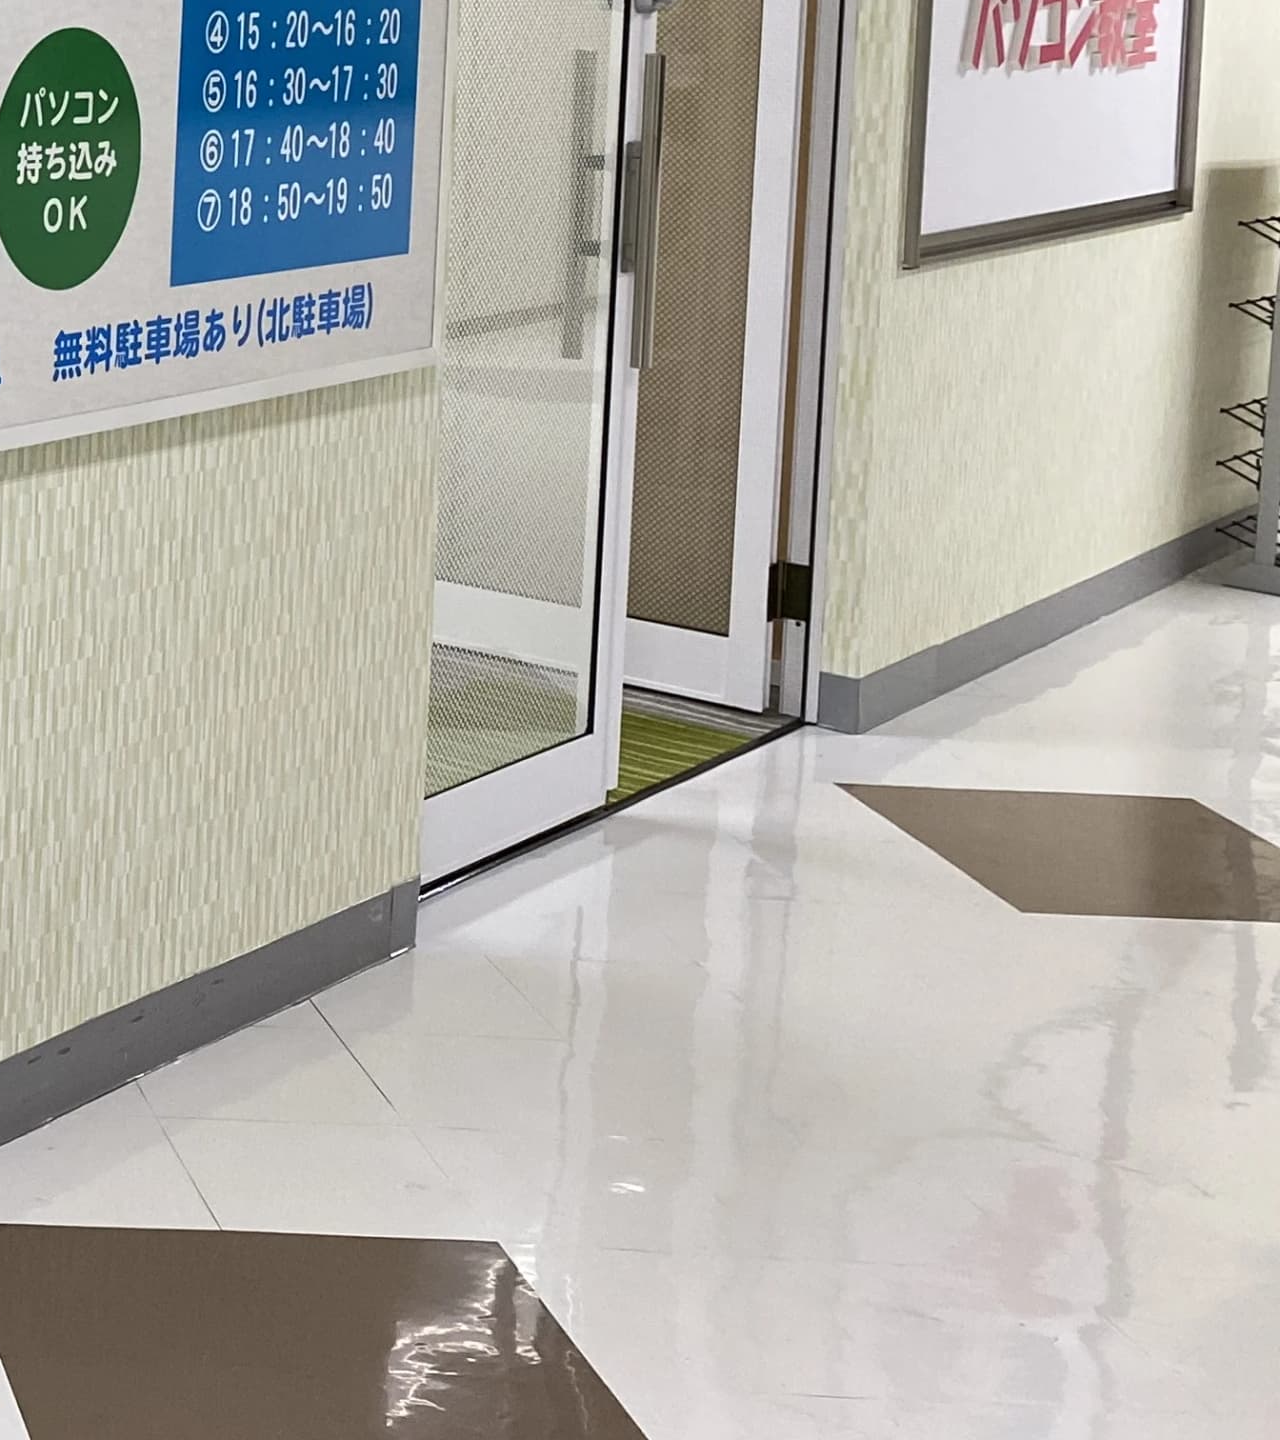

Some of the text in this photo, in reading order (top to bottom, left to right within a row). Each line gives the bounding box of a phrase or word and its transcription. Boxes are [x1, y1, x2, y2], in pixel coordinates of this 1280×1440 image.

[21, 88, 119, 128] パソコン
[17, 140, 117, 185] 持ち込み
[43, 196, 88, 233] OK
